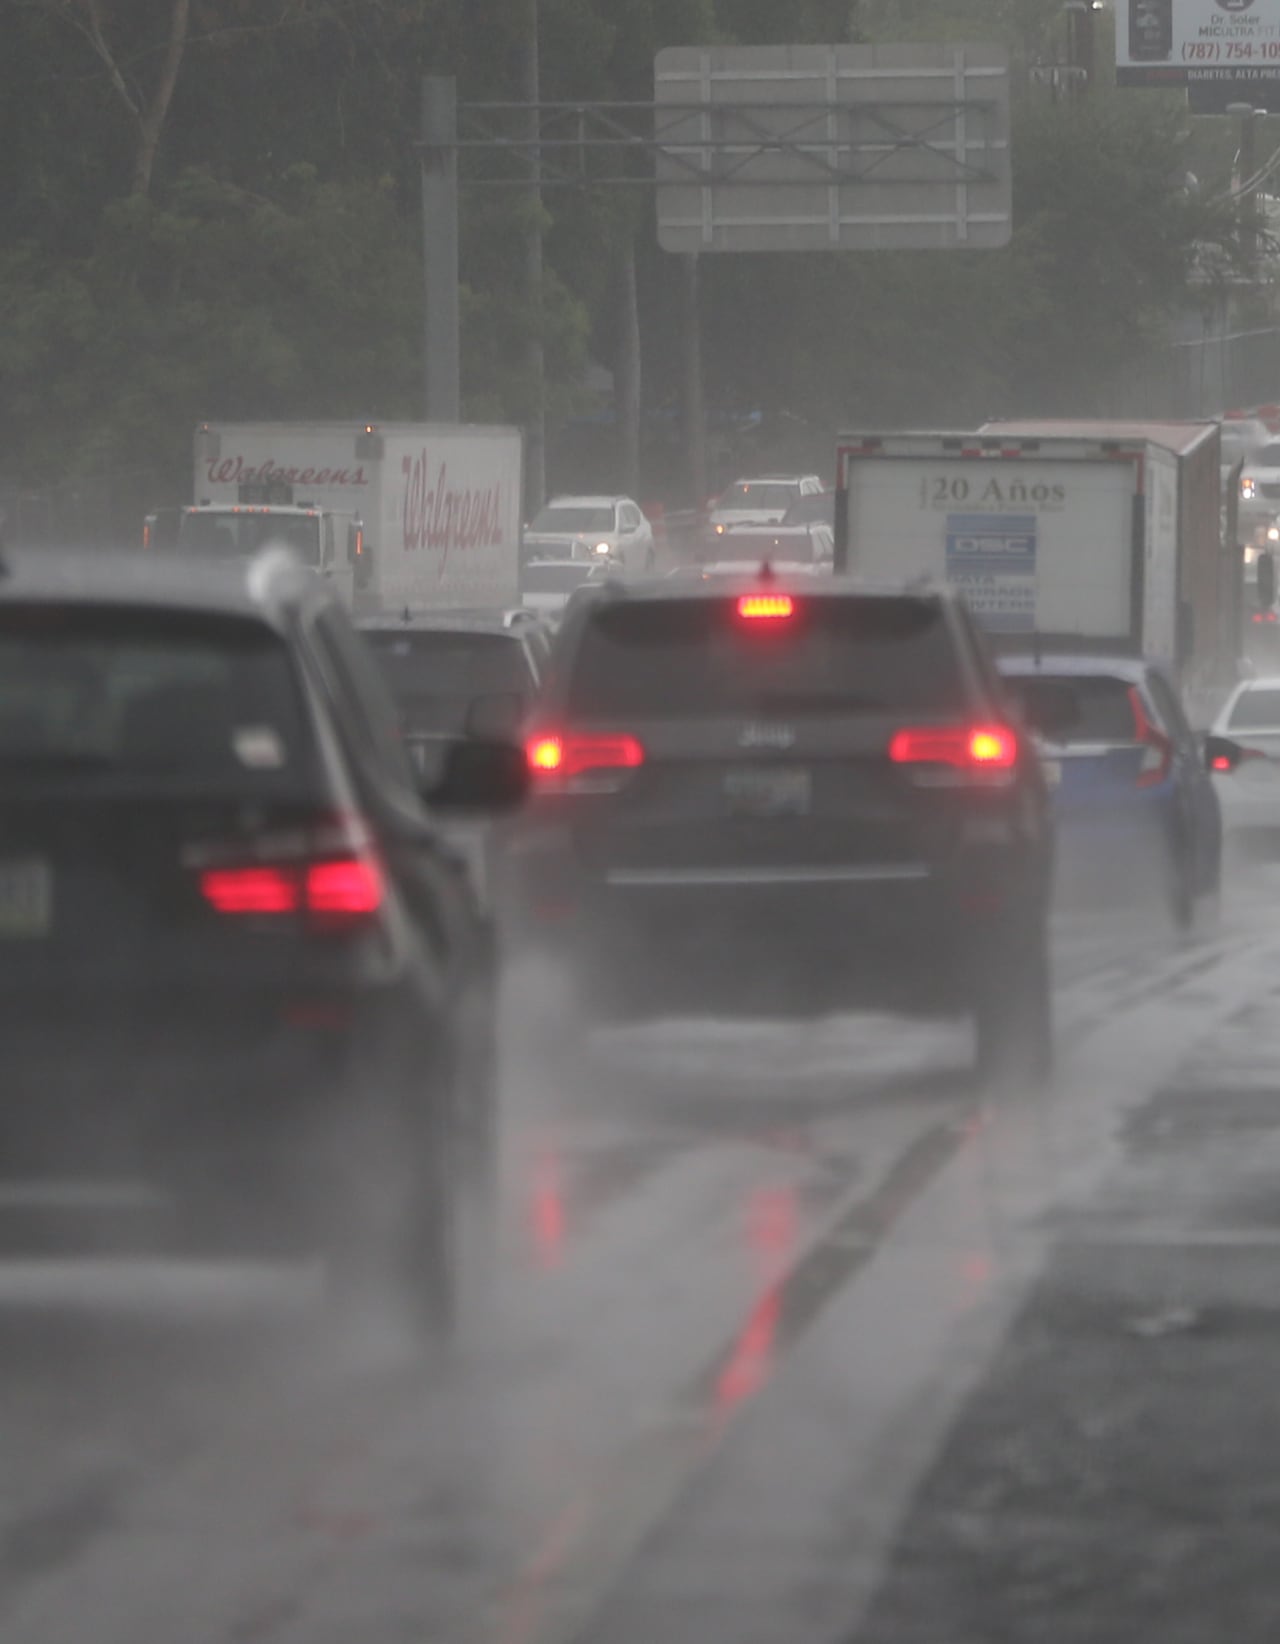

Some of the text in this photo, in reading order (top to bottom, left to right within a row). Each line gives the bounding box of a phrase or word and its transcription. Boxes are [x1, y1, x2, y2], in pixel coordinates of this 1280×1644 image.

[1230, 14, 1260, 25] Soler
[1181, 42, 1221, 61] (787)
[205, 456, 369, 486] Walgreens
[934, 477, 969, 501] 20
[981, 477, 1065, 501] Años
[402, 448, 502, 585] Walgreens
